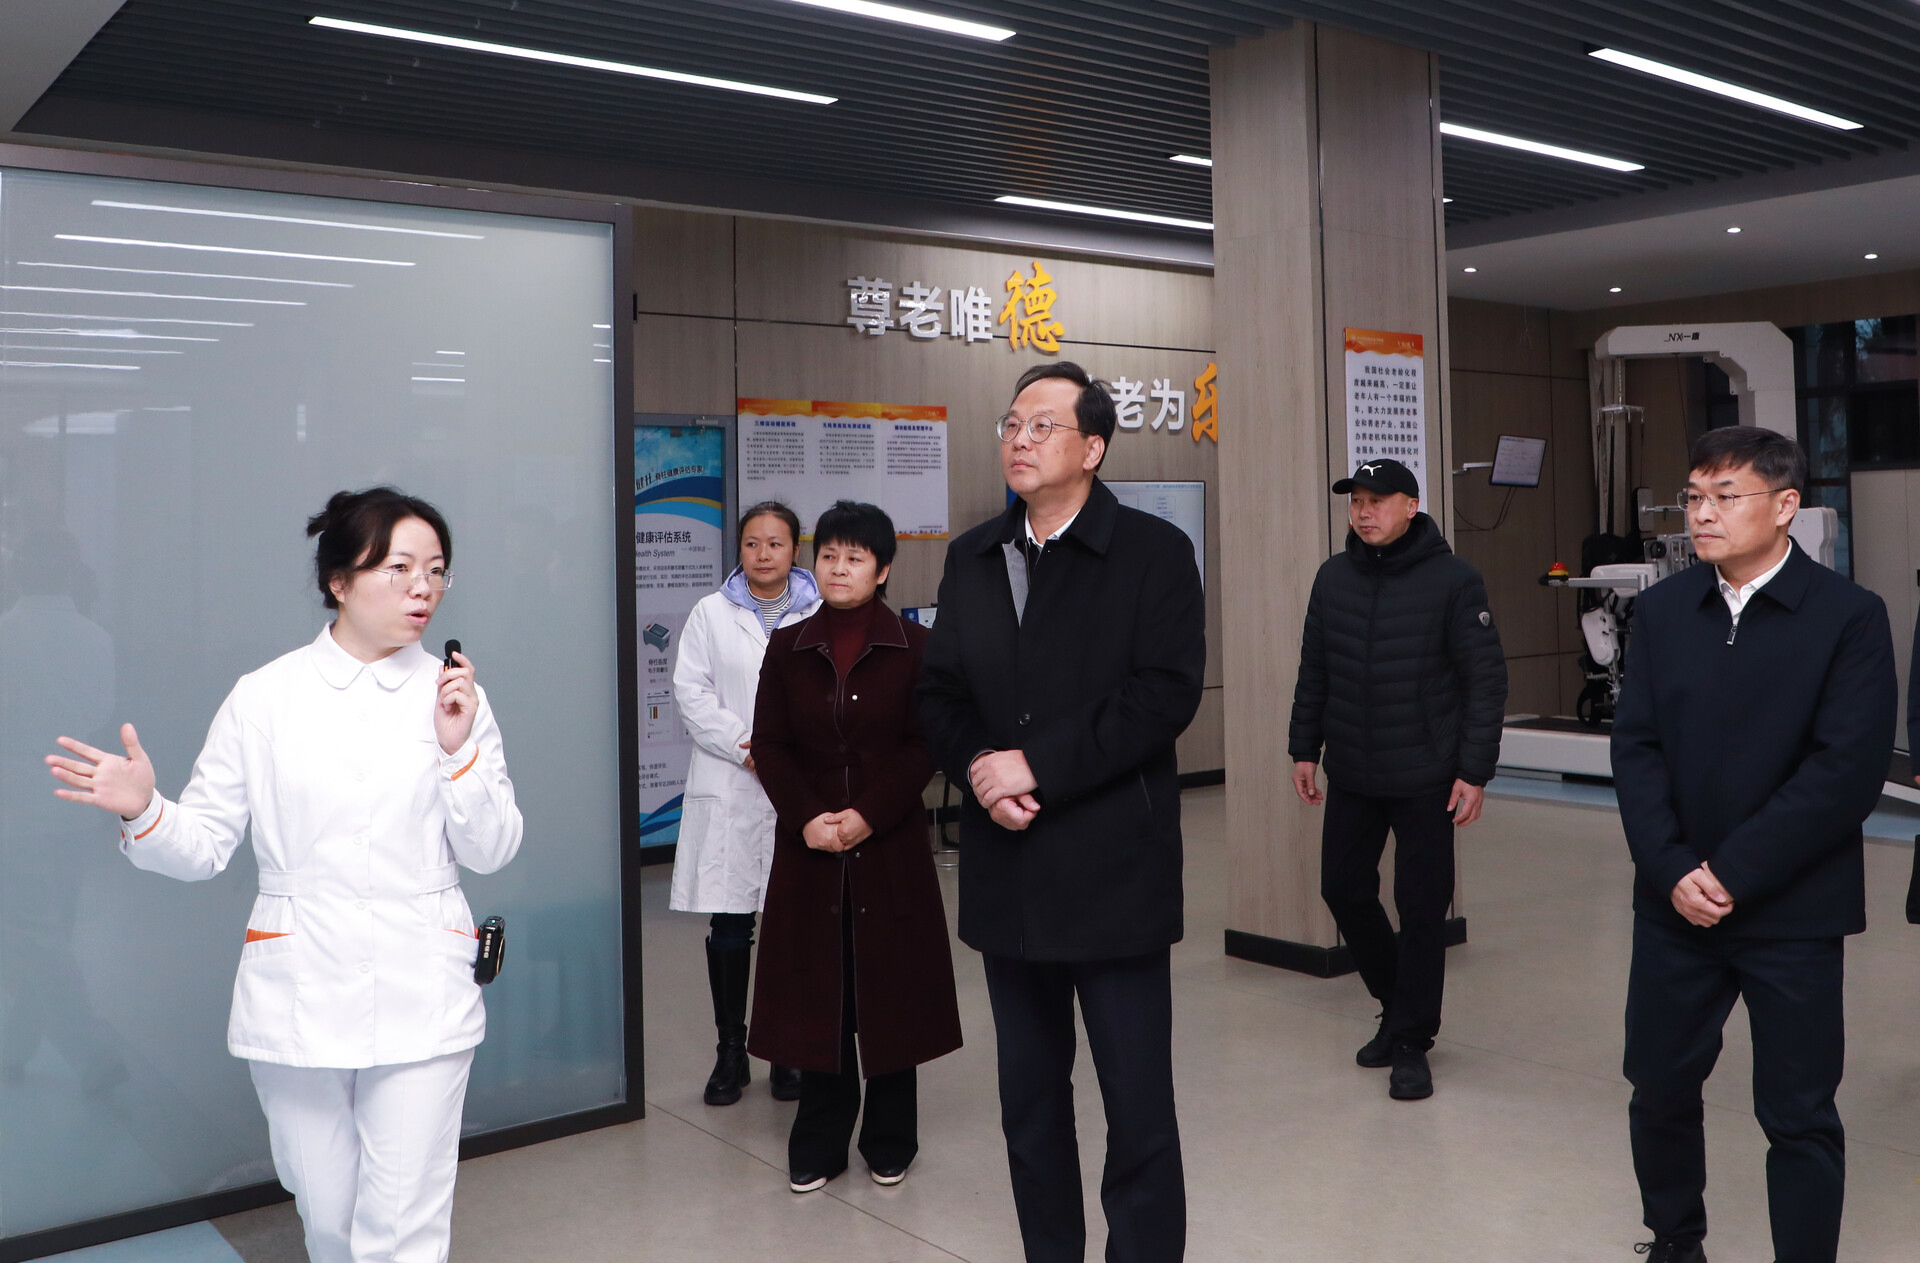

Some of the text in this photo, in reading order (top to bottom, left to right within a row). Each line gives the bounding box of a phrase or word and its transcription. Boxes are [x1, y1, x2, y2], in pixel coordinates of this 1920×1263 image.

[847, 262, 1065, 352] 尊老唯德
[1364, 365, 1417, 377] 我国社会老龄化程
[1354, 379, 1417, 390] 度越来越高，一定要让
[1354, 392, 1418, 403] 老年人有一个幸福的晚
[1355, 432, 1418, 442] 办养老机构和普惠型养
[635, 531, 692, 544] 健康评估系统
[652, 549, 676, 559] System
